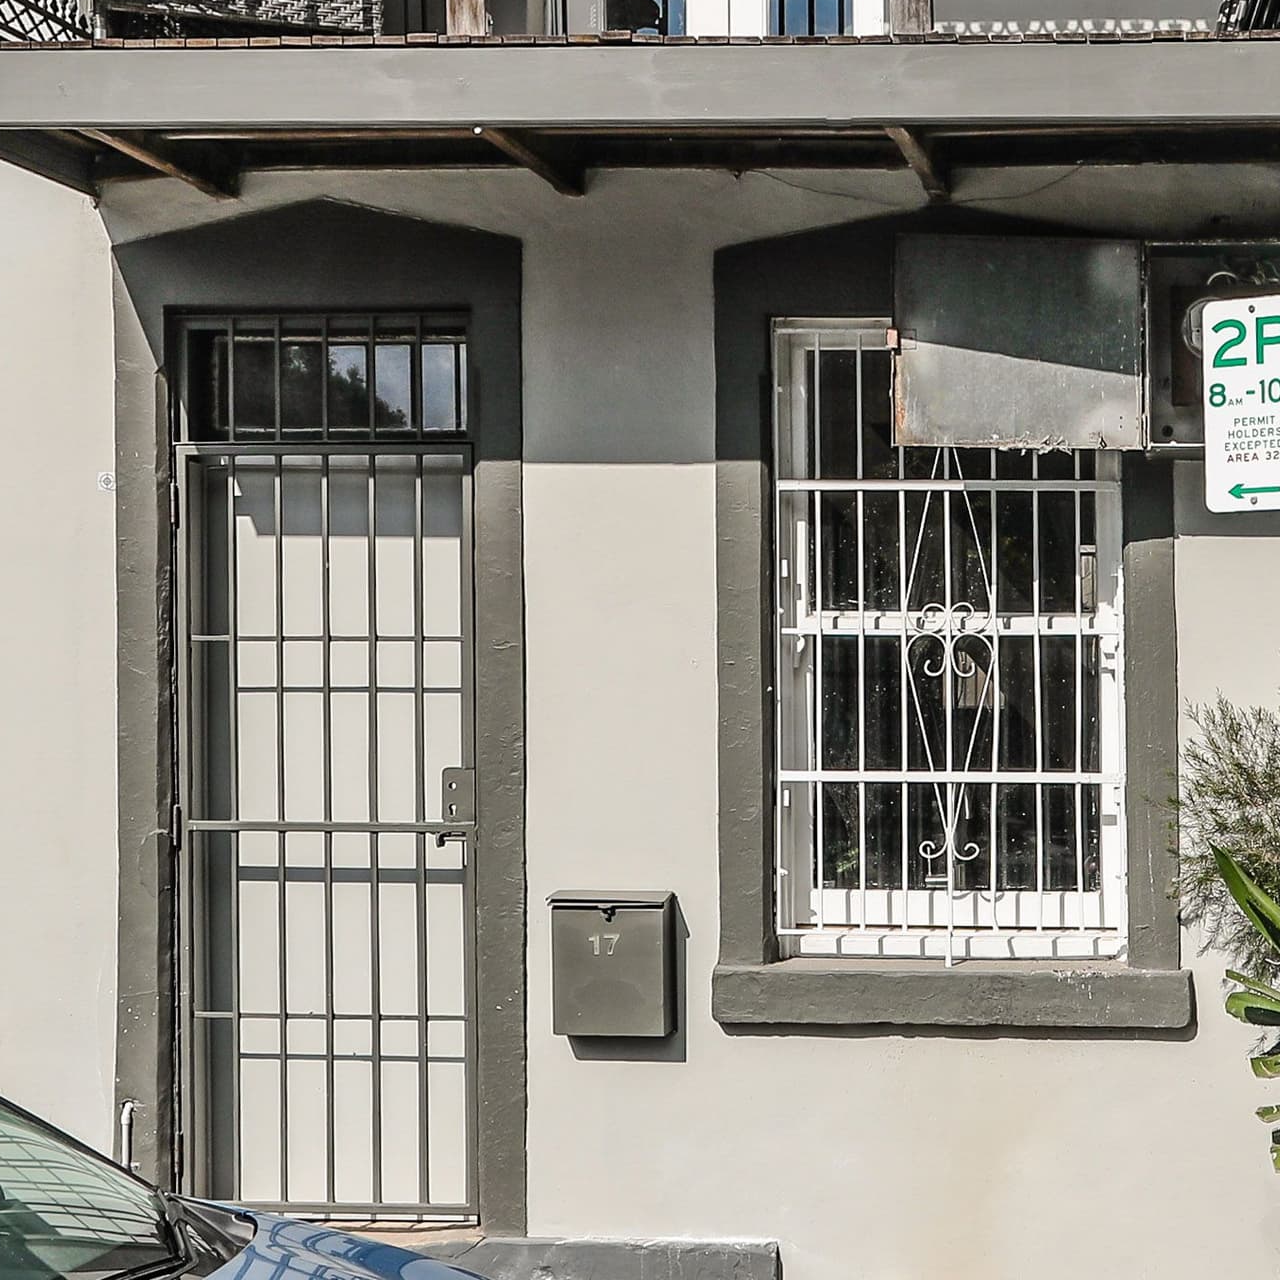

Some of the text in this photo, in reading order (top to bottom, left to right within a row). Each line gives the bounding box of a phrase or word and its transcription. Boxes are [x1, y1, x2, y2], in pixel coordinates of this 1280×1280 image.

[1233, 415, 1275, 427] PERMIT
[1226, 450, 1280, 463] AREA 32
[587, 933, 621, 956] 17
